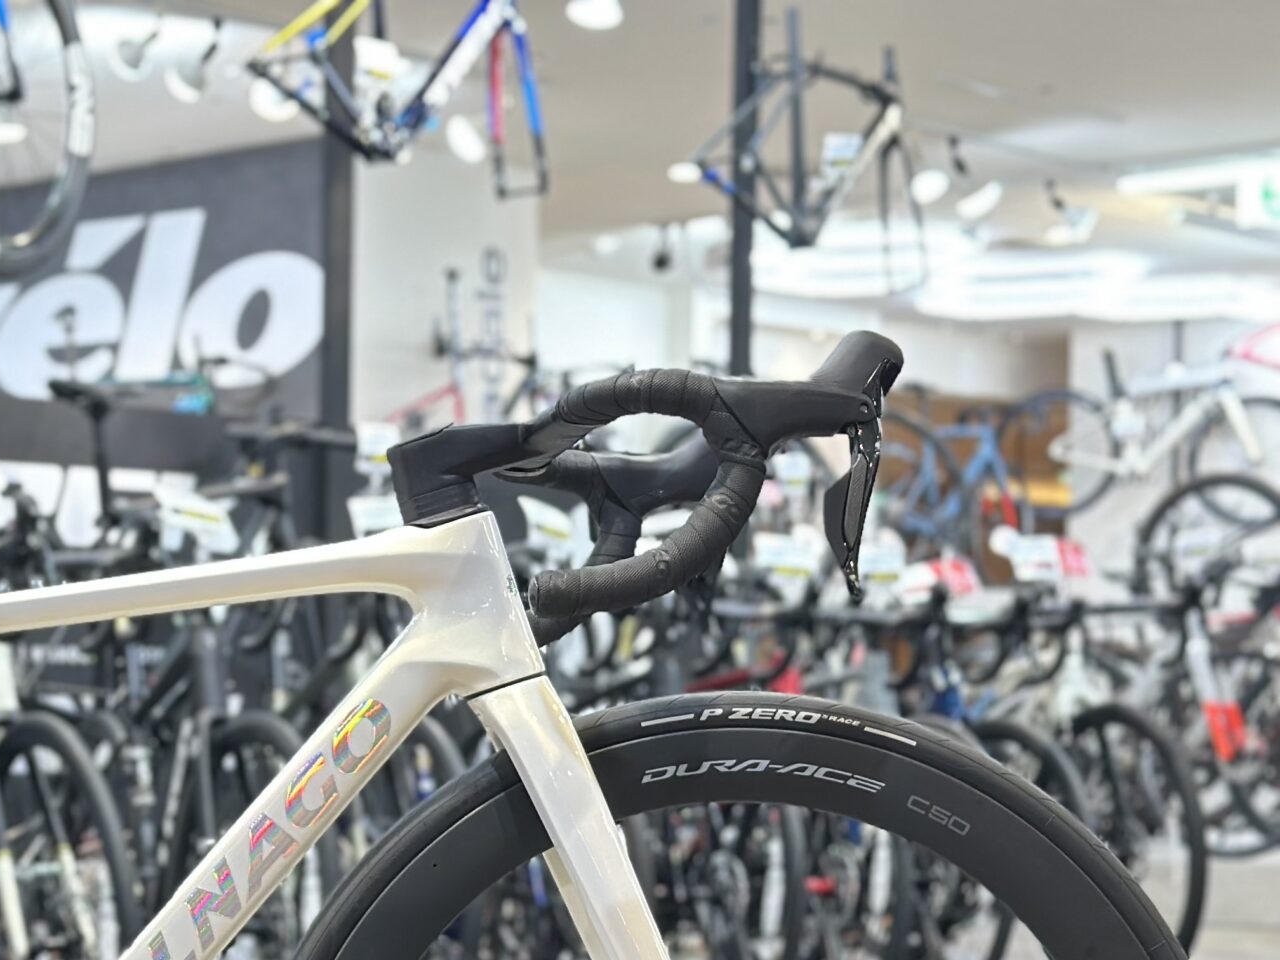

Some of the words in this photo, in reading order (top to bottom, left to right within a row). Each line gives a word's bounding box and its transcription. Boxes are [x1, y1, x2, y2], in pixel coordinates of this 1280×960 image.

[699, 708, 723, 722] P
[728, 707, 822, 724] ZERO
[641, 759, 886, 793] DURA-ACE
[907, 795, 970, 836] C50
